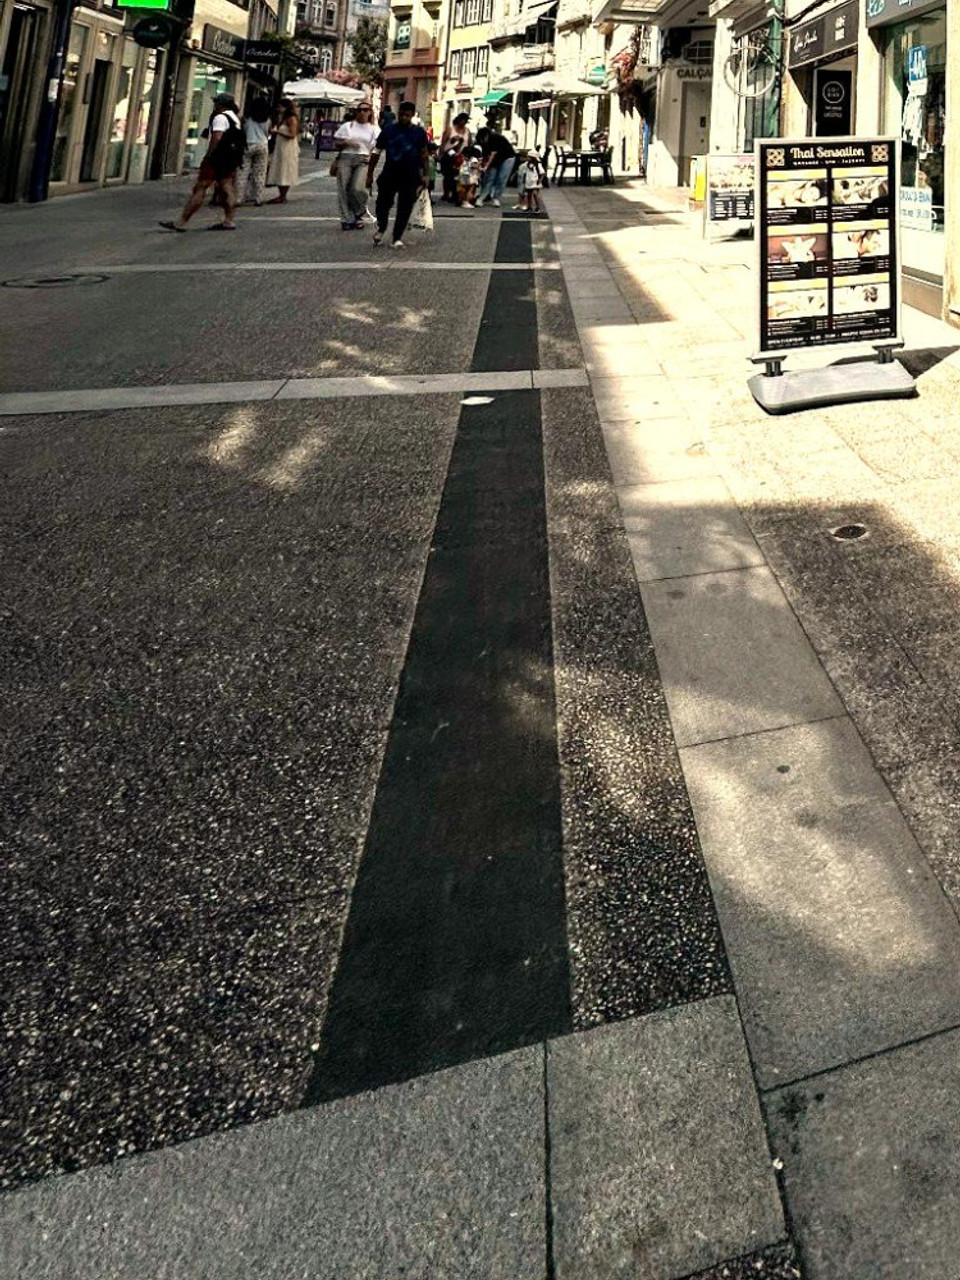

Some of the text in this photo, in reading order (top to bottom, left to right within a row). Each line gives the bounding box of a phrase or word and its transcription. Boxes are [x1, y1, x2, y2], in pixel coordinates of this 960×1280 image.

[245, 47, 279, 58] October
[789, 145, 865, 159] Thai Sensation
